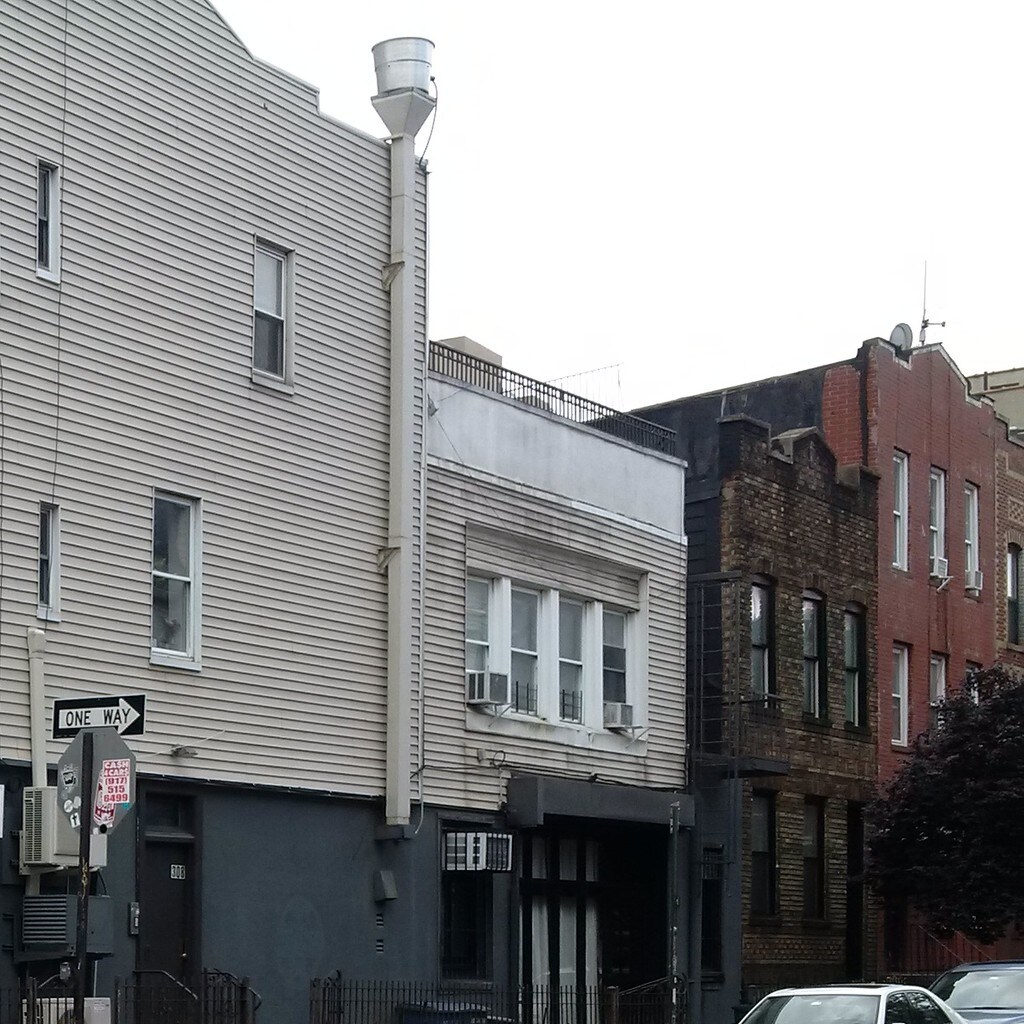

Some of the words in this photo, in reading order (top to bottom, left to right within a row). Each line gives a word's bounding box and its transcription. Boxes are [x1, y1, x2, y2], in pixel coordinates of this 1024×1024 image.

[65, 710, 91, 727] ONE
[103, 708, 131, 725] WAY
[107, 785, 125, 794] 515
[103, 793, 128, 803] 6499
